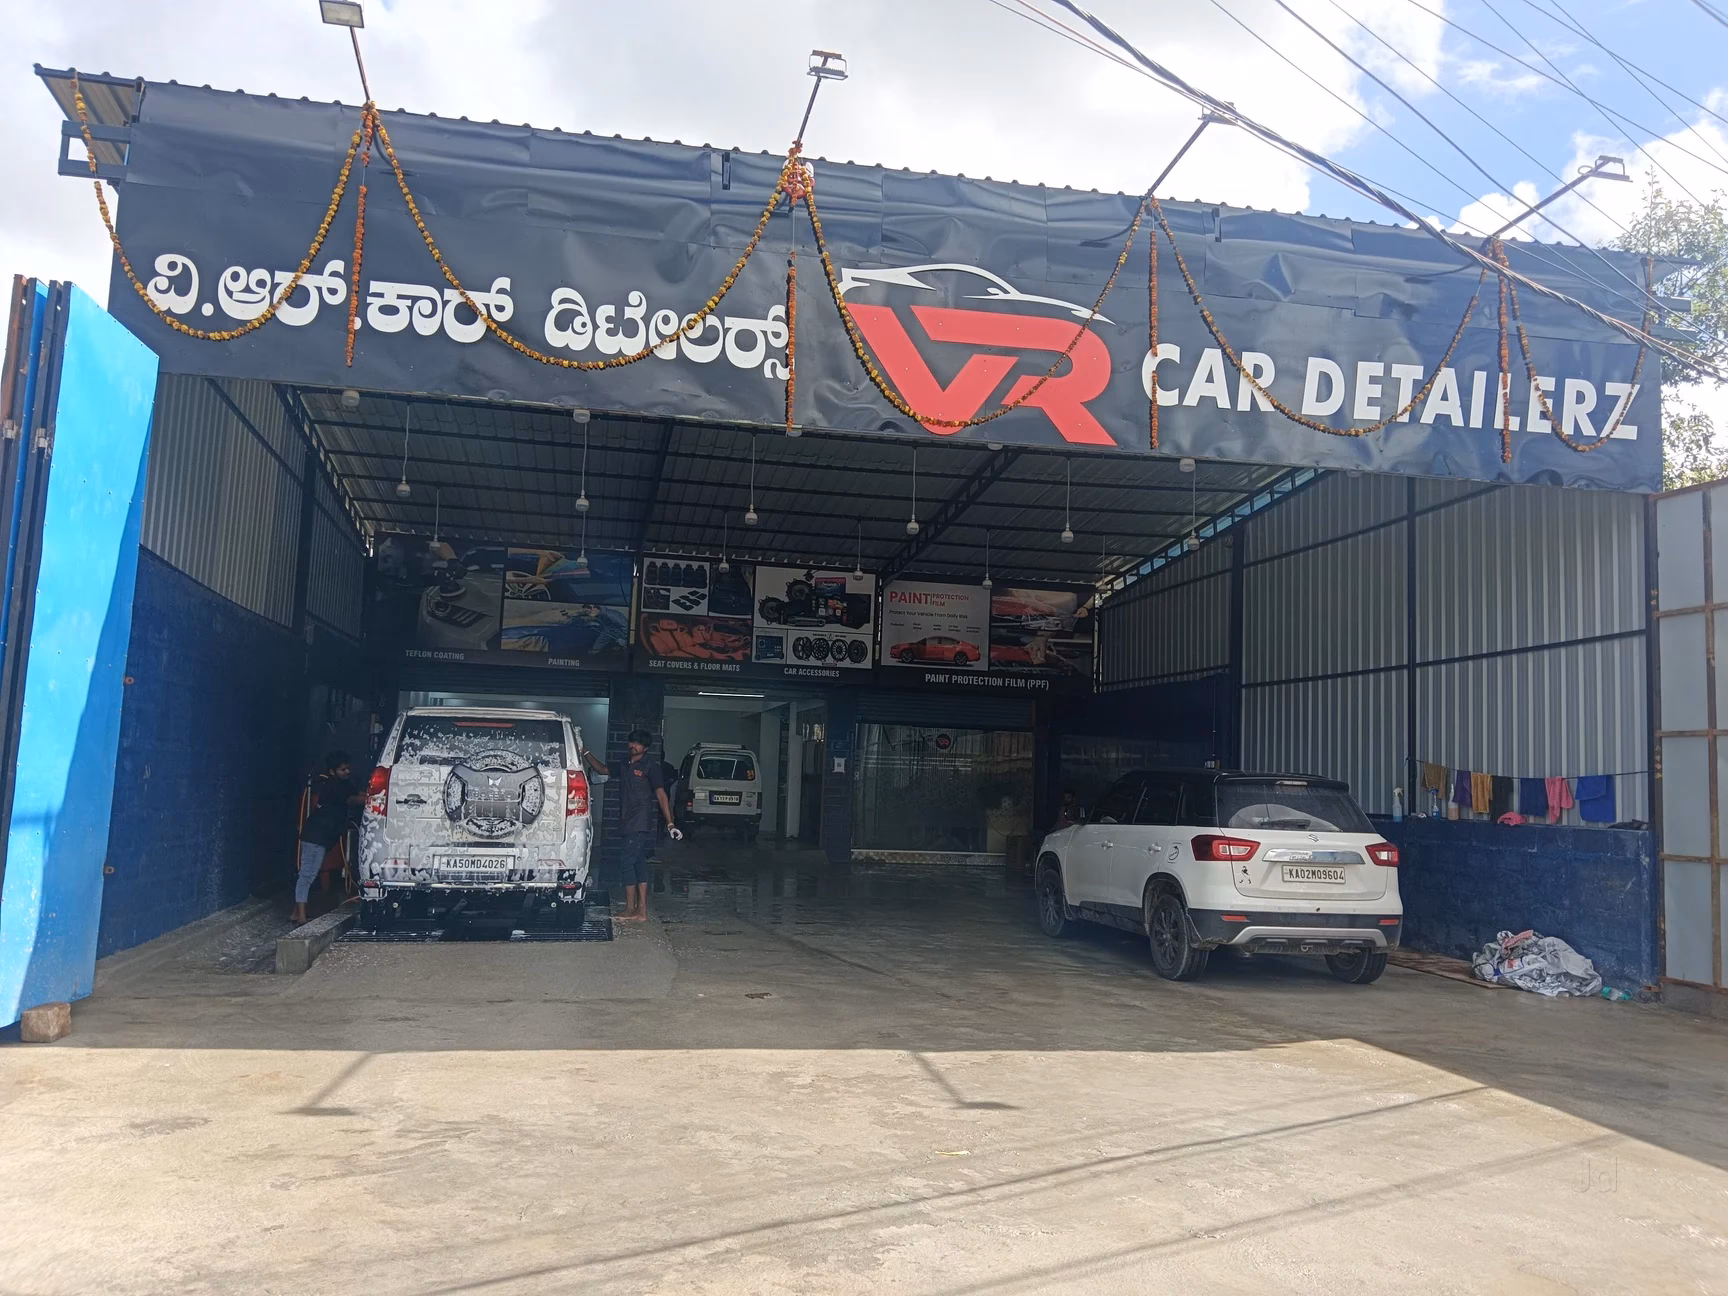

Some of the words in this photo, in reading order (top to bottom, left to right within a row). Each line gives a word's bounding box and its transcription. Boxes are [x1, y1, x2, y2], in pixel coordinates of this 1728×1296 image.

[845, 303, 1118, 446] VR
[1141, 343, 1276, 412] CAR
[1301, 356, 1641, 441] DETAILERZ
[889, 591, 931, 606] PAINT
[932, 592, 969, 601] PROTECTION
[405, 650, 432, 659] TEFLON
[433, 651, 464, 660] COATING
[548, 658, 580, 667] PAINTING
[649, 660, 665, 668] SEAT
[667, 660, 692, 669] COVERS
[701, 662, 721, 671] FLOOR
[722, 663, 740, 672] MATS
[784, 667, 797, 676] CAR
[798, 668, 840, 678] ACCESSORIES
[925, 674, 949, 684] PAINT
[952, 675, 1003, 687] PROTECTION
[1005, 677, 1025, 688] FILM
[1027, 679, 1049, 690] (PPF)
[446, 859, 506, 869] KA50MD4026
